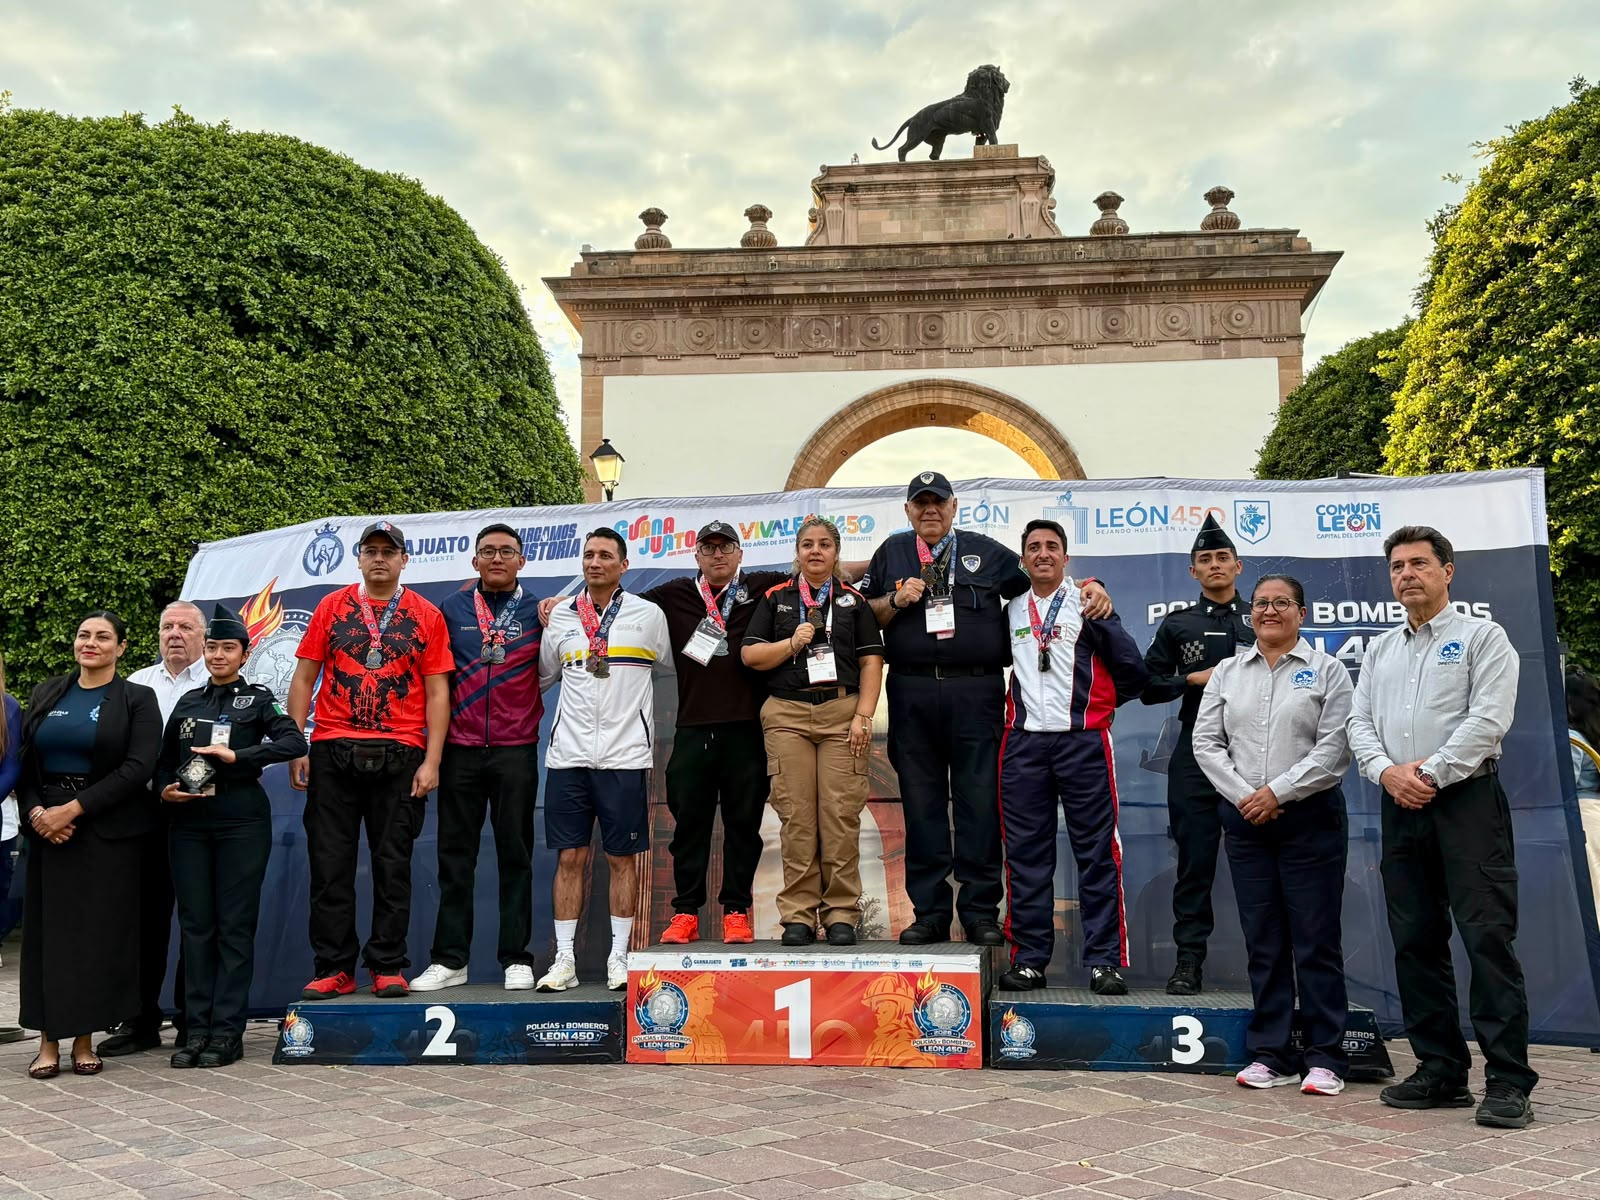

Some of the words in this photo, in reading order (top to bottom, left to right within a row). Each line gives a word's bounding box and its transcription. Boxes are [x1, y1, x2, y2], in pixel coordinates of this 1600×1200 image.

[953, 500, 1010, 526] EÓN
[1316, 502, 1380, 515] COMUDE
[521, 538, 581, 561] ISTORIA
[1312, 601, 1493, 624] BOMBOS
[526, 1021, 560, 1031] POLICÍAS
[566, 1022, 609, 1030] BOMBEROS
[774, 977, 812, 1058] 1
[421, 1005, 457, 1056] 2
[540, 1030, 569, 1040] LEÓN
[570, 1032, 594, 1040] 450
[1171, 1015, 1205, 1064] 3
